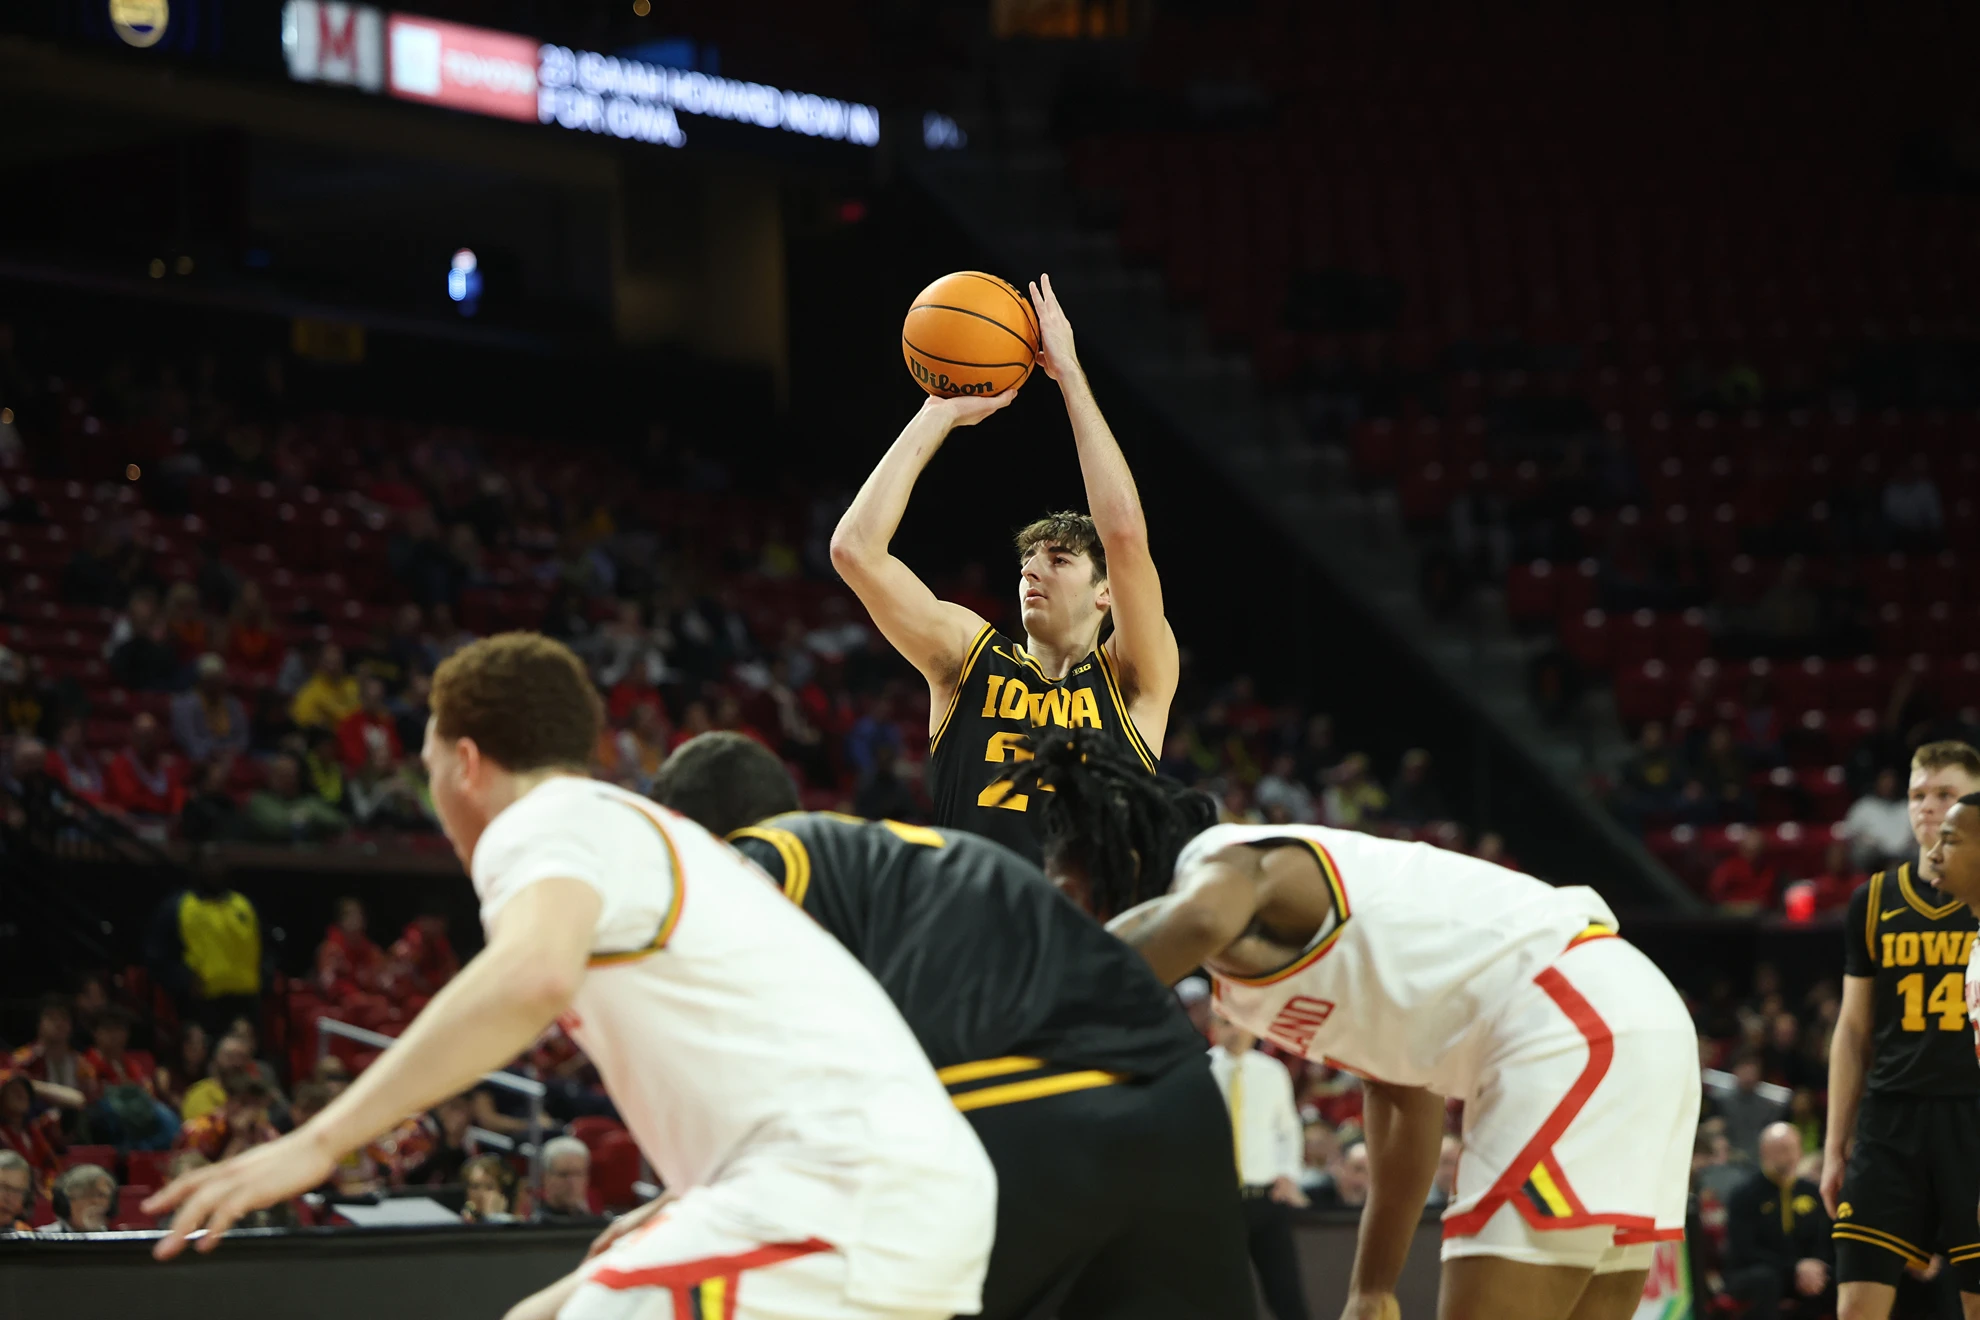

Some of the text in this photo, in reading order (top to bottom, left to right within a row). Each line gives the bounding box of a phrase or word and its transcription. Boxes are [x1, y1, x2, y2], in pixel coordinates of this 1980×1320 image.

[909, 355, 994, 395] Wilson
[981, 675, 1103, 730] IOWA
[1897, 972, 1968, 1032] 14
